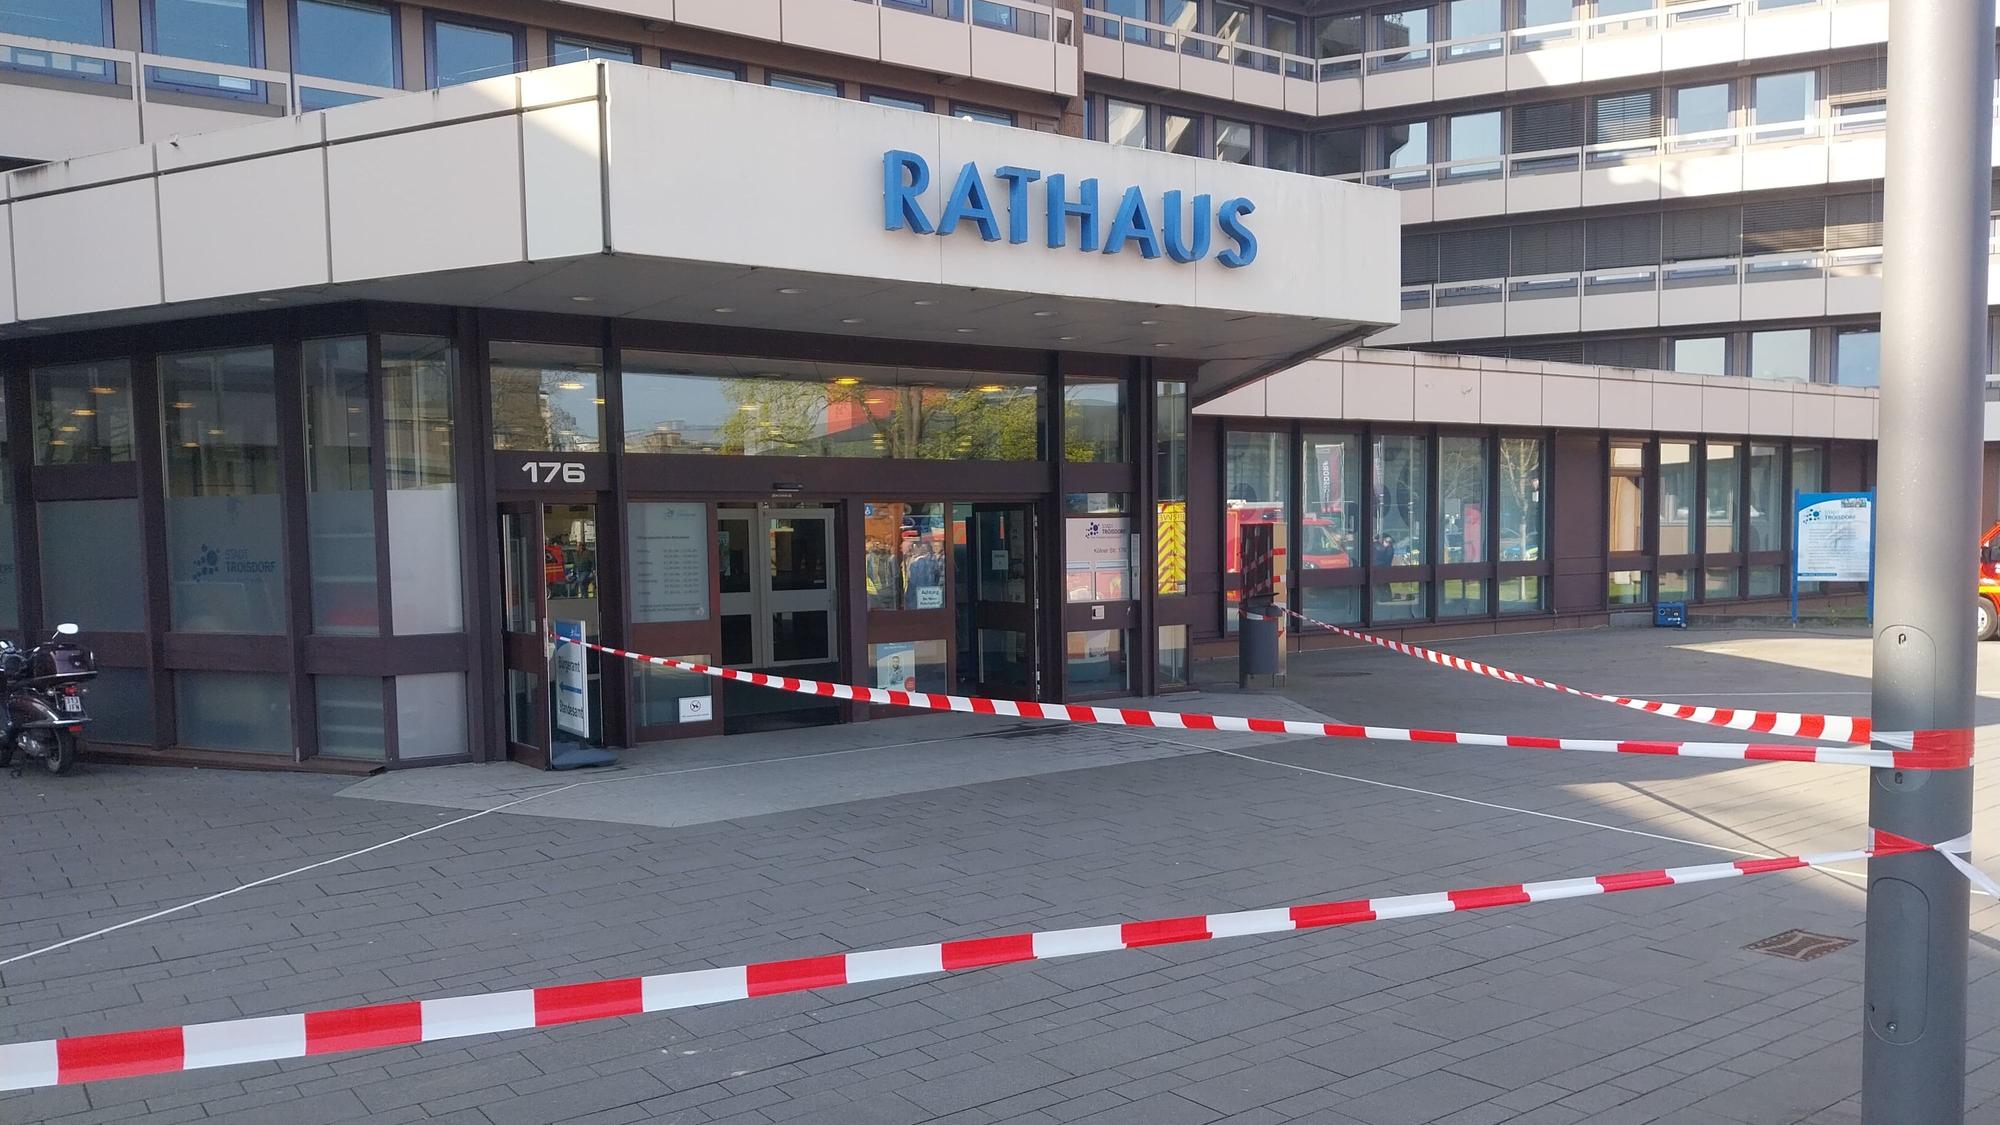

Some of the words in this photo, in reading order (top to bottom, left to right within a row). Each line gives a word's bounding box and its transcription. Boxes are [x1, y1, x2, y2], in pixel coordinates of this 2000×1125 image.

[883, 149, 1258, 268] RATHAUS
[521, 462, 586, 483] 176
[225, 561, 276, 573] TROISDORF
[560, 699, 584, 720] Standesamt
